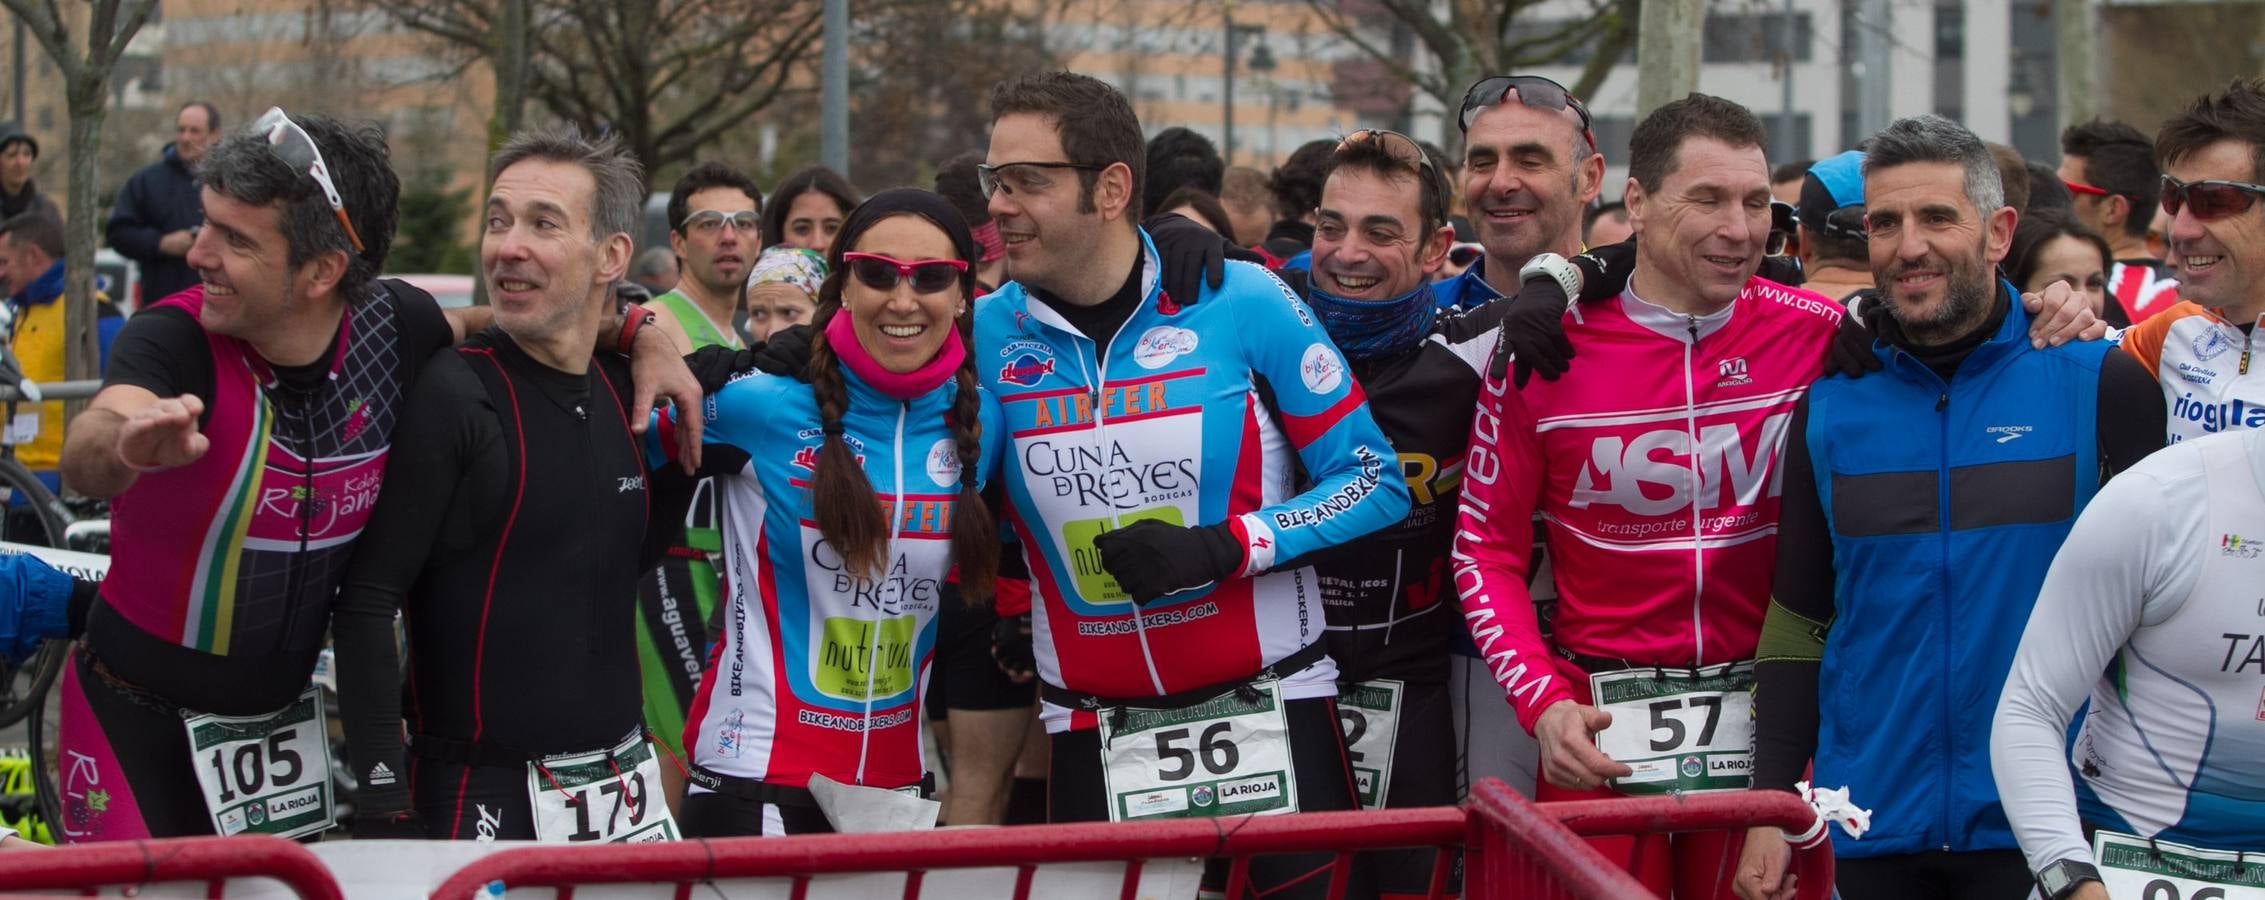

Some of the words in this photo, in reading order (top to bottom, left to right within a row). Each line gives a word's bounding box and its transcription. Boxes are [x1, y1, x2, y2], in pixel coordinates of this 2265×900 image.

[1036, 383, 1168, 428] AIRFER
[1986, 425, 2033, 433] BROOKS
[1025, 439, 1132, 477] CUNA
[1568, 410, 1794, 517] ASM
[1144, 489, 1193, 504] BODEGAS
[1597, 517, 1687, 538] transporte
[1692, 510, 1759, 532] urgente
[1648, 696, 1723, 752] 57
[211, 728, 304, 804] 105
[1154, 720, 1240, 782] 56
[1711, 759, 1726, 770] LA
[1727, 758, 1750, 770] RIOJ
[271, 800, 288, 814] LA
[288, 793, 318, 811] RIOJA
[564, 771, 647, 842] 179
[1223, 784, 1239, 797] LA
[1240, 781, 1277, 796] RIOJA
